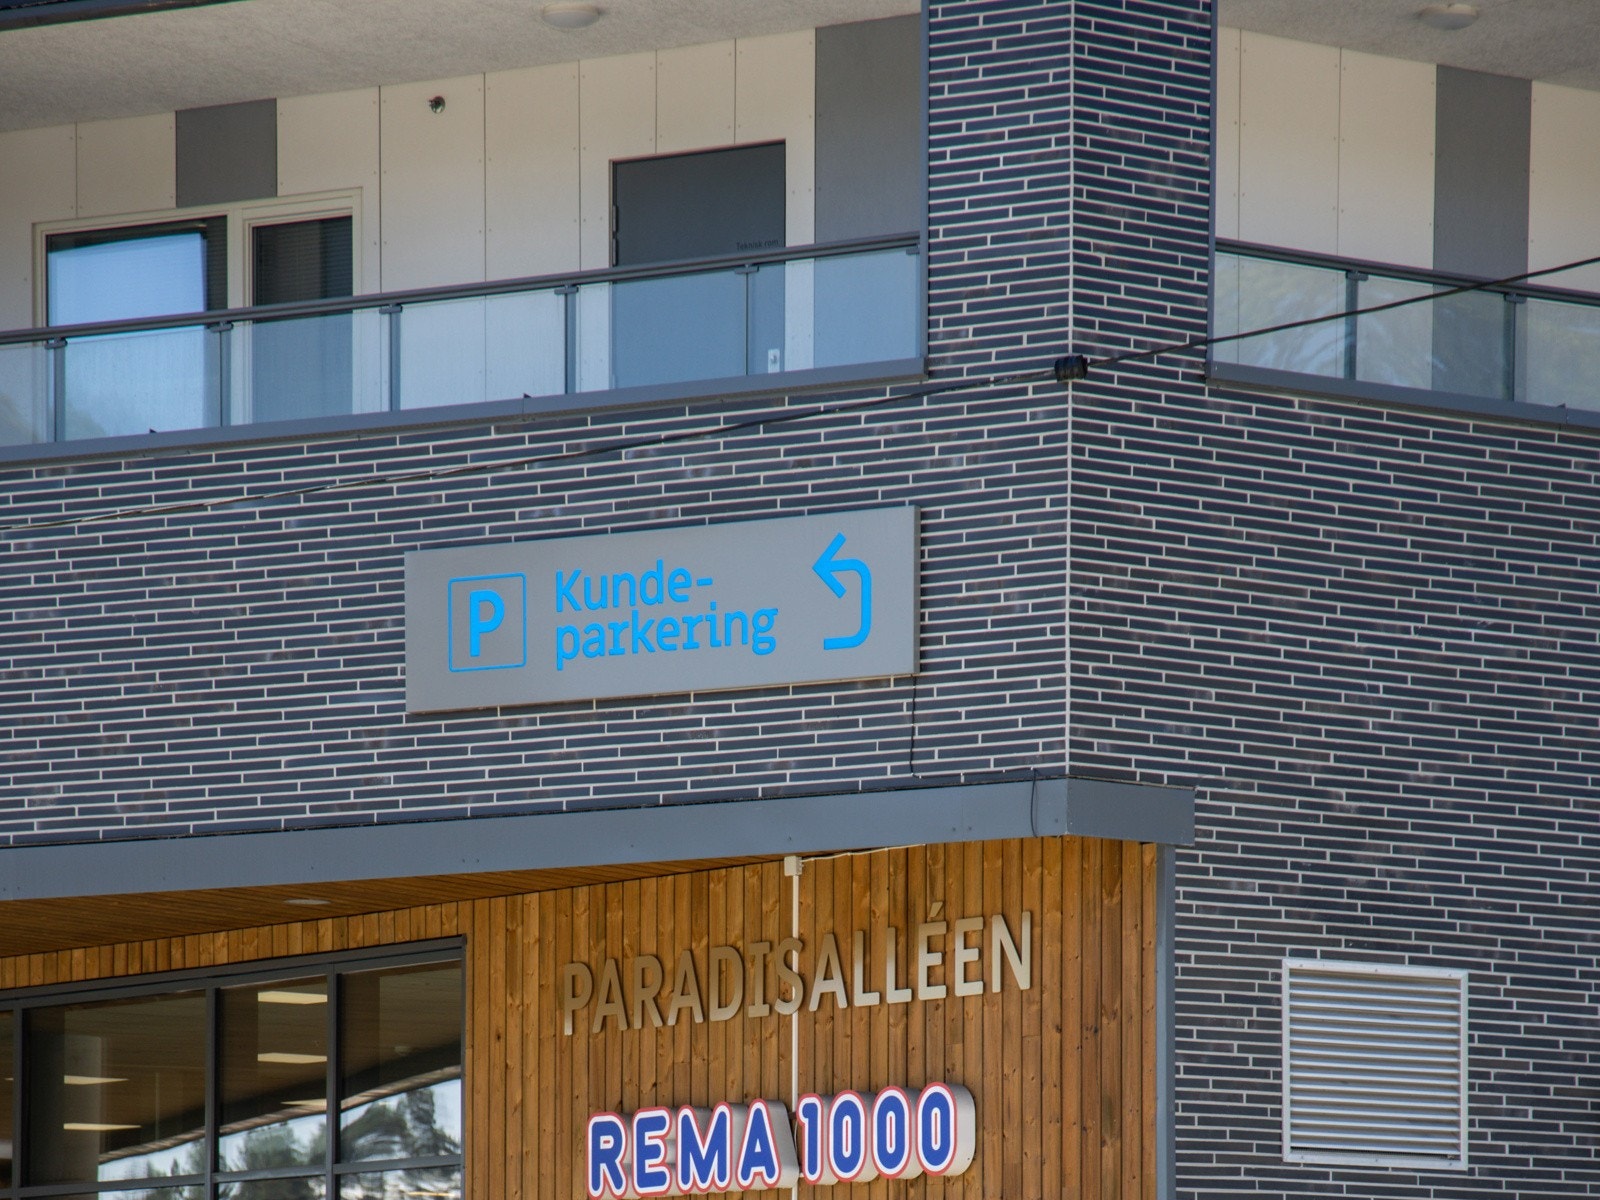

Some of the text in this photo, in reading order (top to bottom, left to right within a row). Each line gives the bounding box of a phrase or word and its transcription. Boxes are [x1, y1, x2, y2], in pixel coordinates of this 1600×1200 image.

[556, 559, 713, 613] Kunde-
[469, 590, 505, 657] P
[556, 602, 778, 671] parkering
[563, 902, 1032, 1036] PARADISALLÉEN
[587, 1081, 960, 1200] REMA 1000
